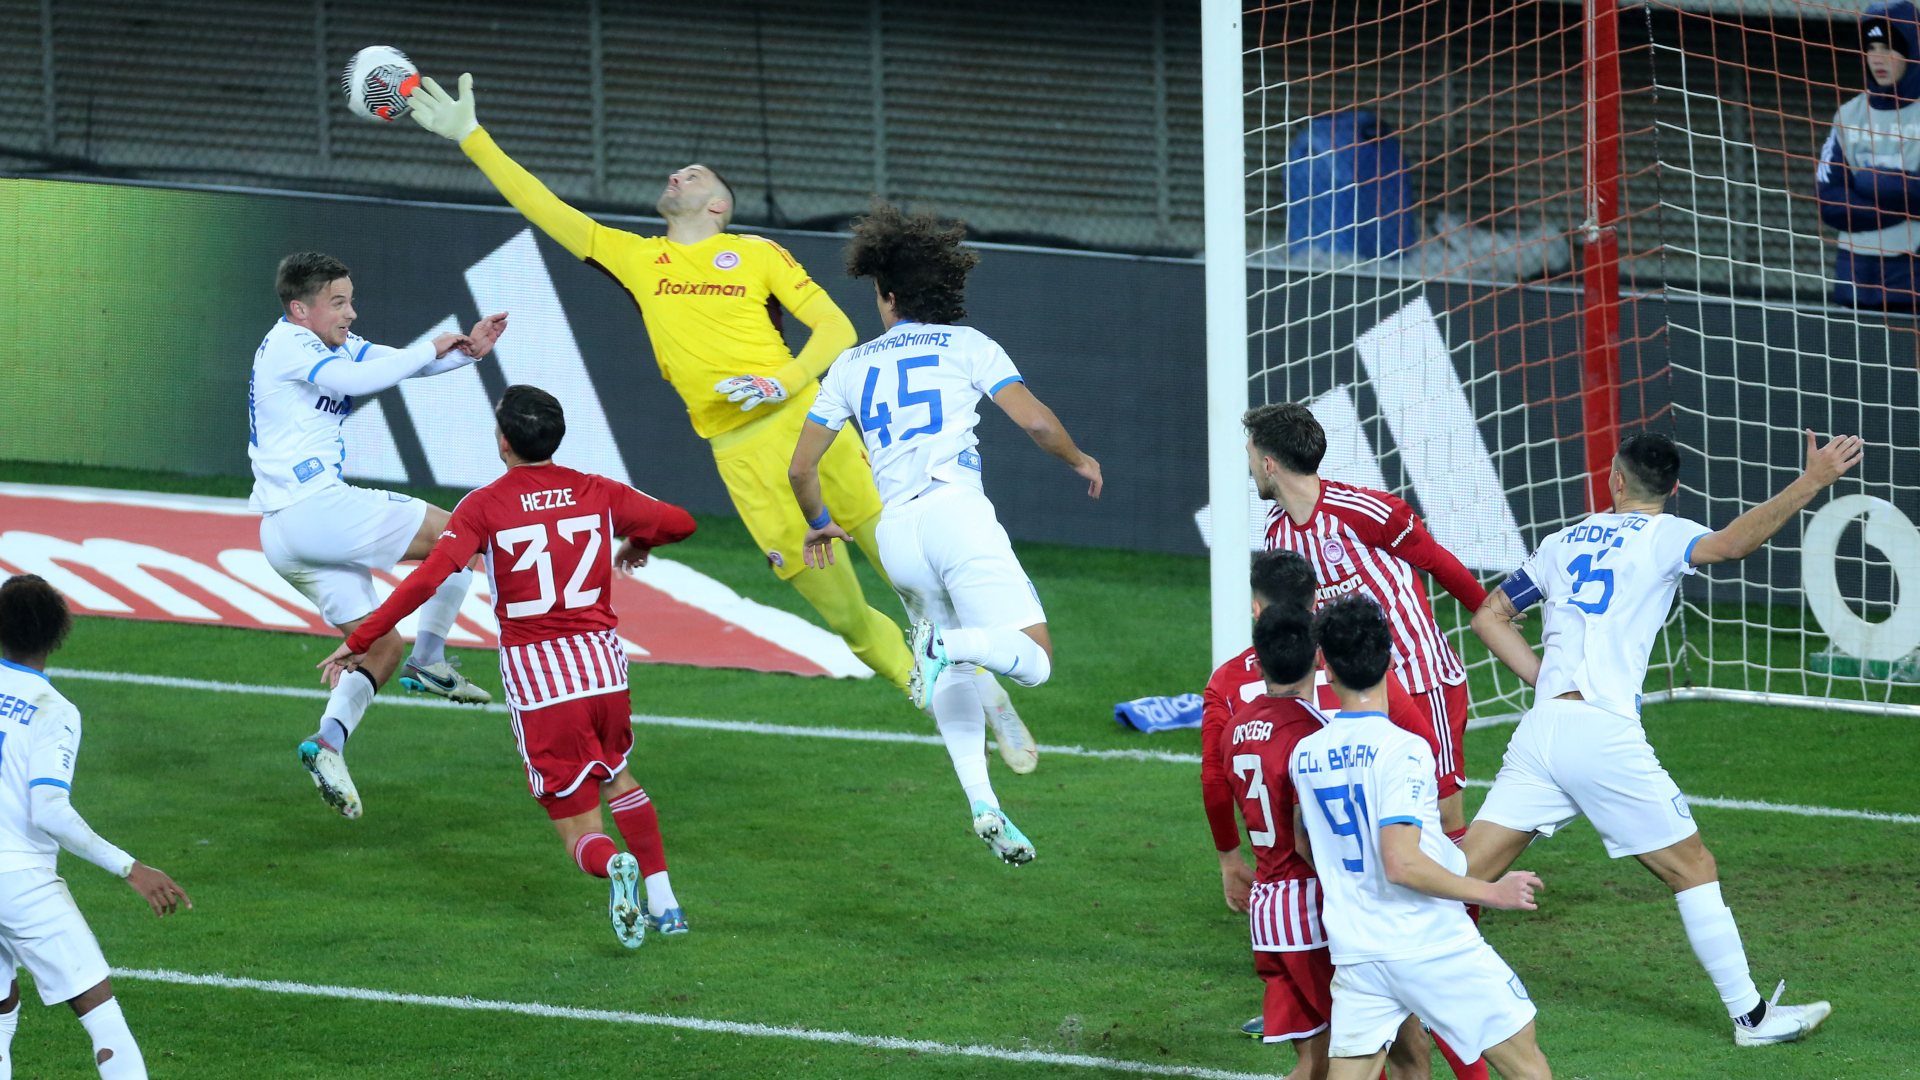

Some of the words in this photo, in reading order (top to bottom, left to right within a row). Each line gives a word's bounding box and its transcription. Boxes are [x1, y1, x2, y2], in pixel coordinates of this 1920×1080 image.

[654, 278, 746, 298] Stoiximan
[860, 354, 943, 448] 45
[520, 488, 577, 512] HEZZE
[495, 513, 603, 618] 32
[1233, 753, 1276, 848] 3
[1313, 784, 1371, 872] 91
